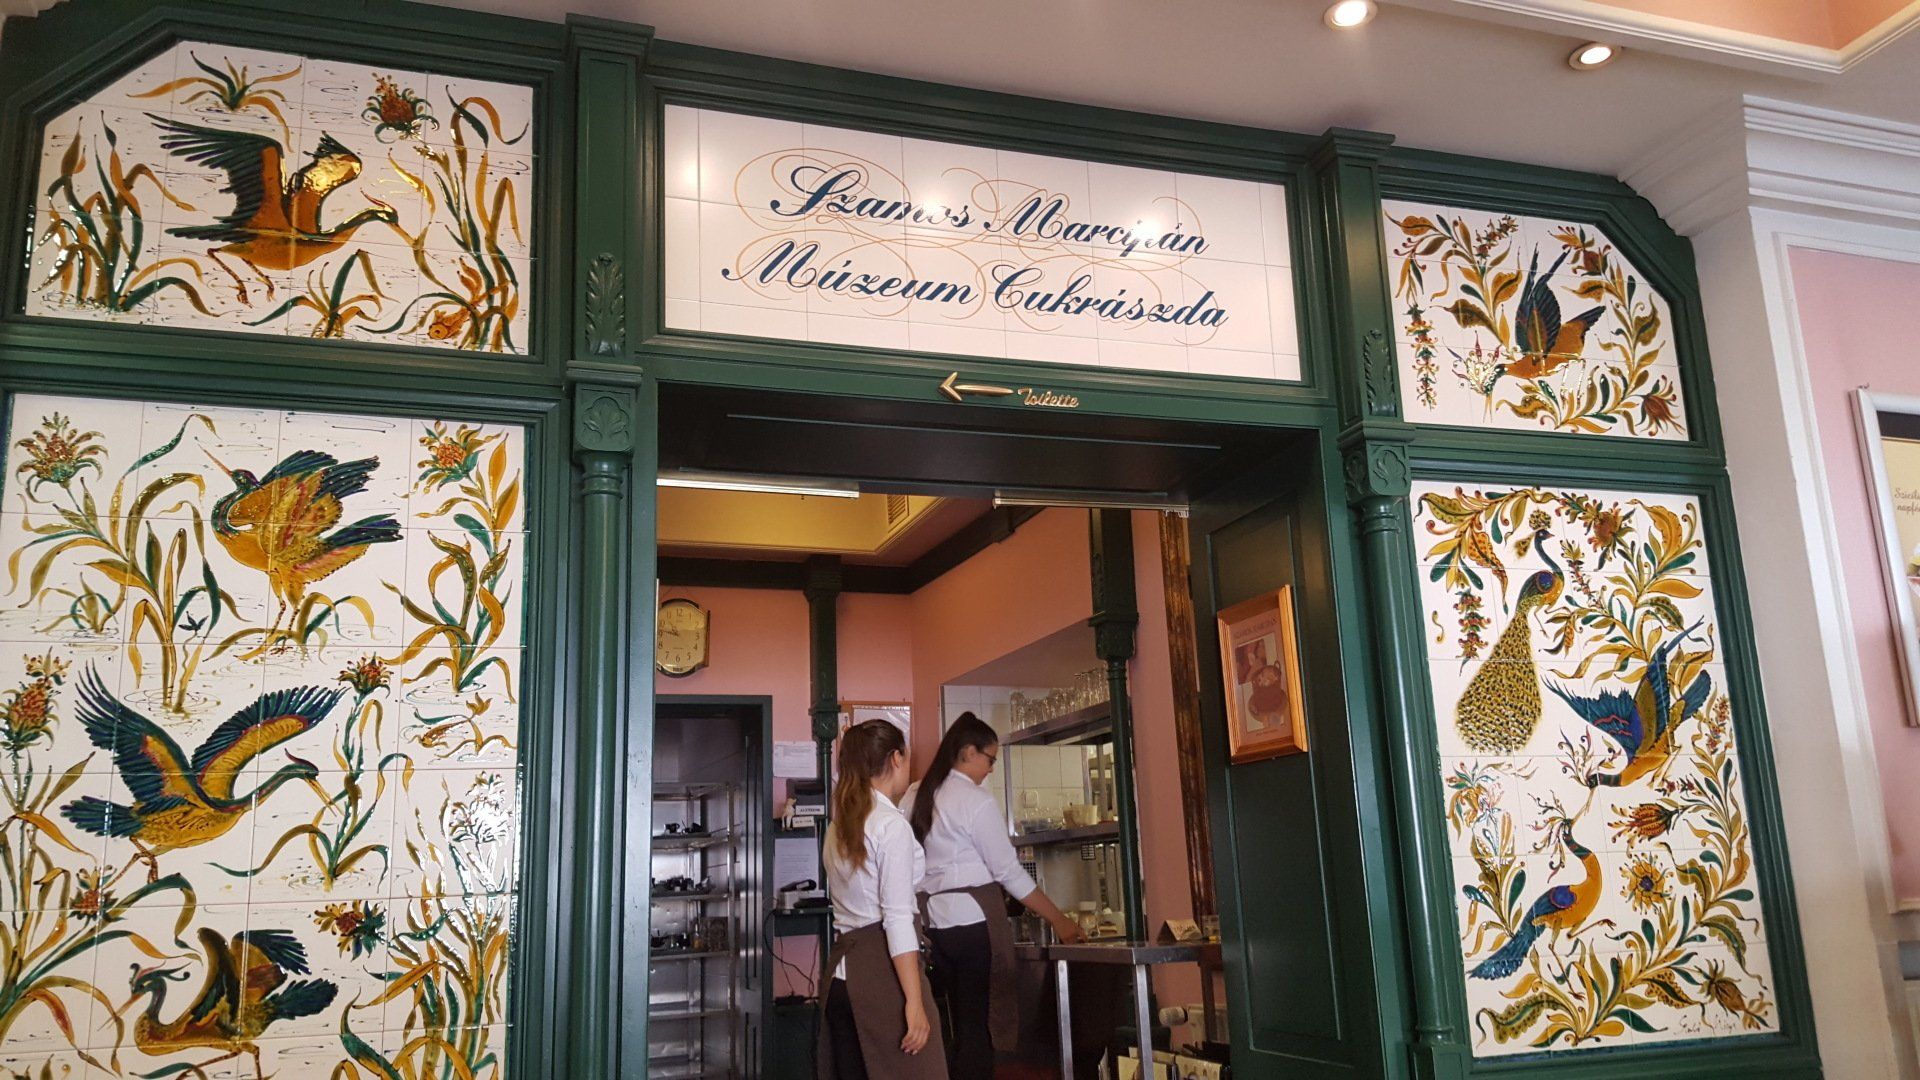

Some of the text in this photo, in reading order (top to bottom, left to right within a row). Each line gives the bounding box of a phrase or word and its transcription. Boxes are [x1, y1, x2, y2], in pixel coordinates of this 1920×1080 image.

[770, 166, 975, 228] Szamos
[721, 240, 1229, 327] Múzeum Cukrászda
[1017, 387, 1080, 408] Toilette
